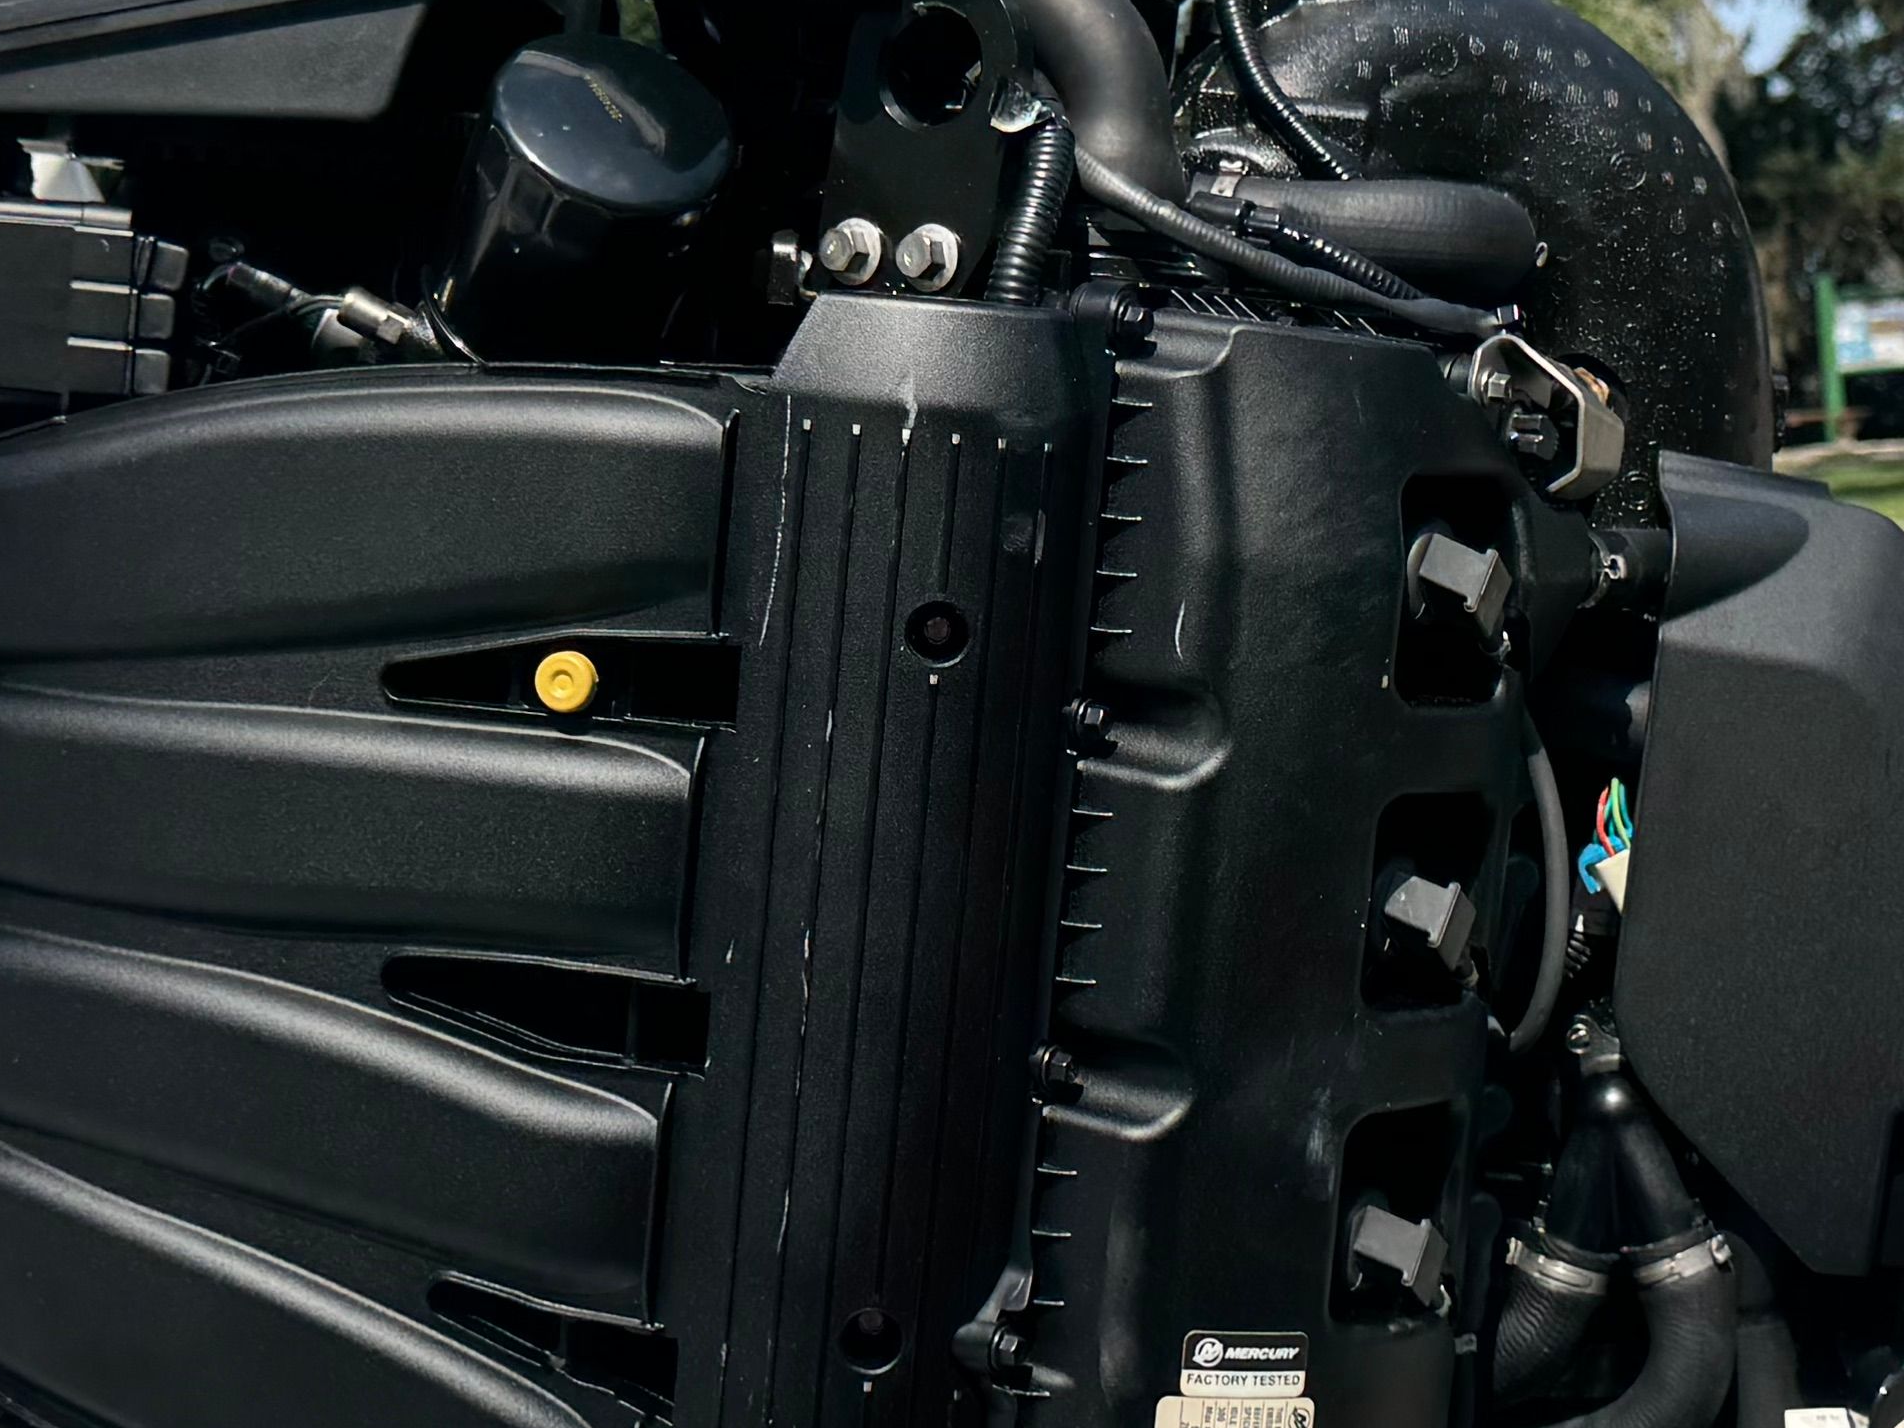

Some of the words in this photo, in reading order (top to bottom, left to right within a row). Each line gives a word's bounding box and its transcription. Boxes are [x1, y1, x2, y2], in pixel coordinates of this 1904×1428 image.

[1224, 1347, 1300, 1360] MERCURY
[1187, 1373, 1248, 1387] FACTORY
[1254, 1374, 1300, 1386] TESTED
